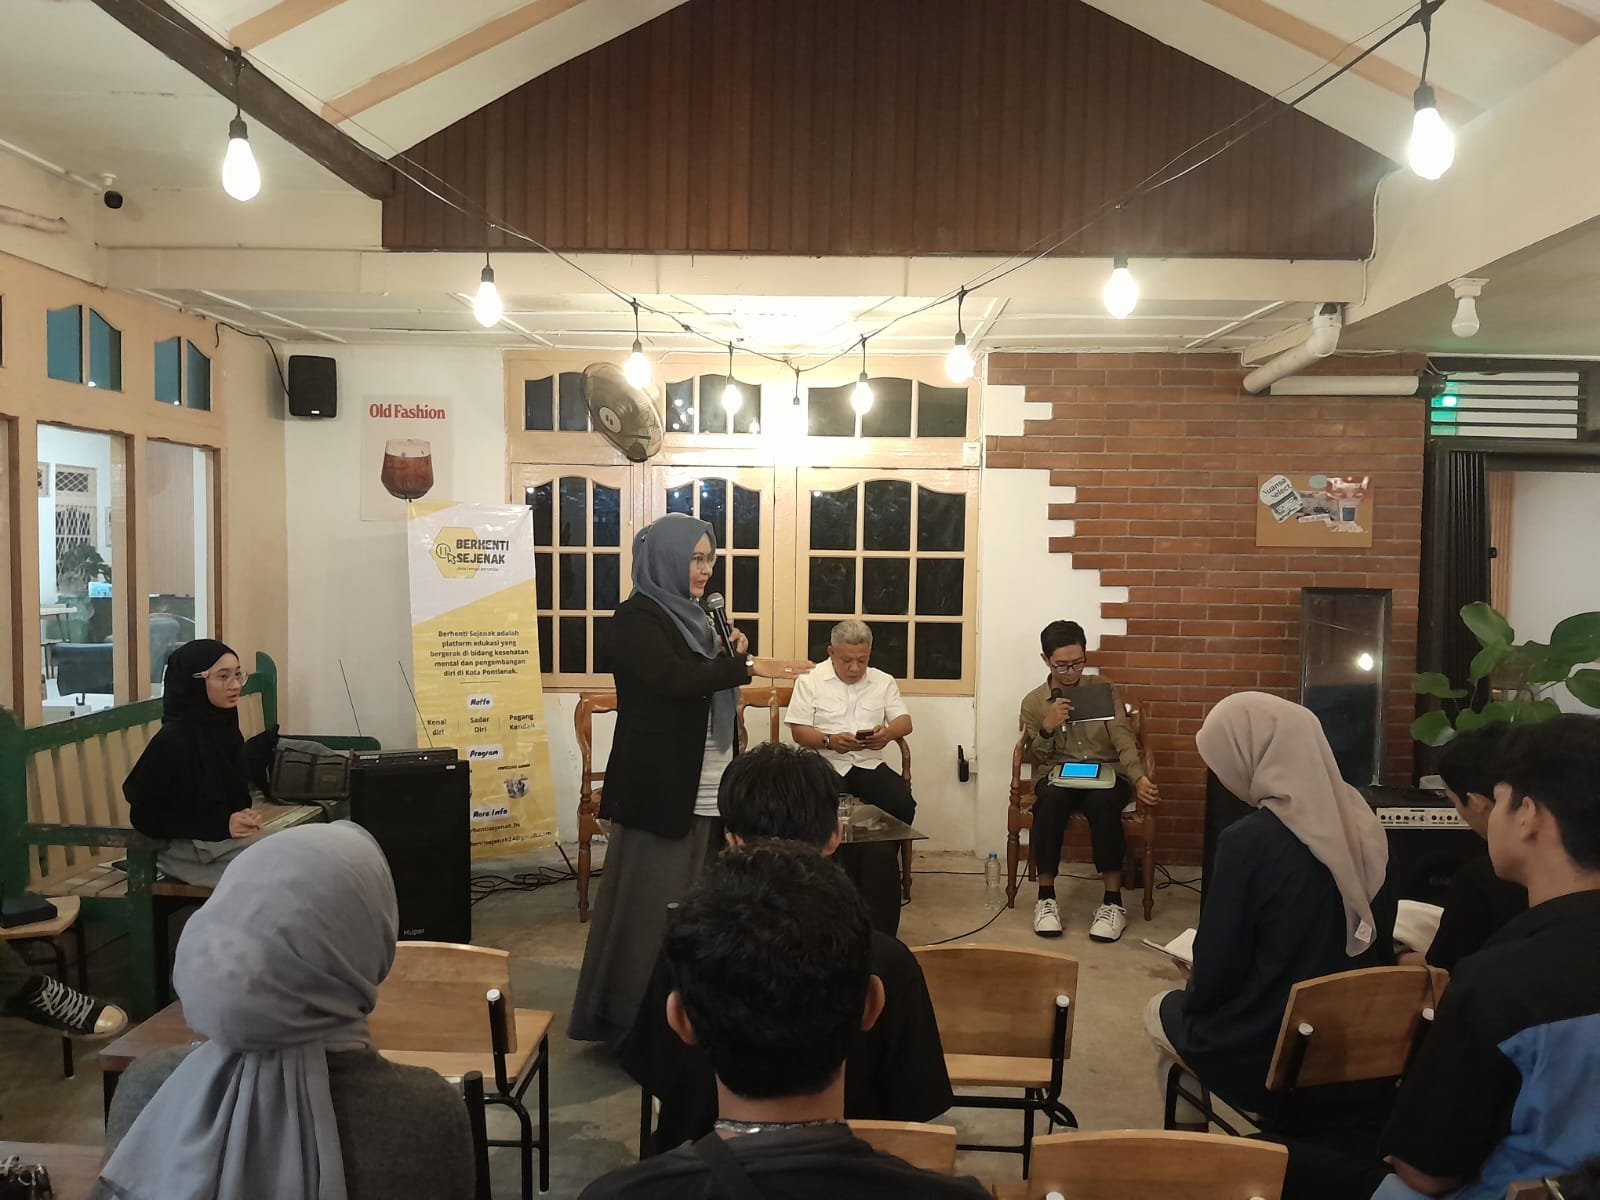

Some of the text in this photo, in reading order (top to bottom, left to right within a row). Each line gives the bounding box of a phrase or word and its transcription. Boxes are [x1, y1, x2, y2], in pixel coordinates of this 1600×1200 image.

[369, 403, 446, 420] Old Fashion
[456, 539, 509, 551] BERHENTI
[456, 553, 505, 564] SEJENAK
[470, 630, 495, 638] Sejenak
[442, 640, 472, 648] platform
[430, 650, 460, 658] bergerak
[475, 659, 526, 667] pengembangan
[470, 750, 499, 759] Program
[473, 809, 490, 818] More
